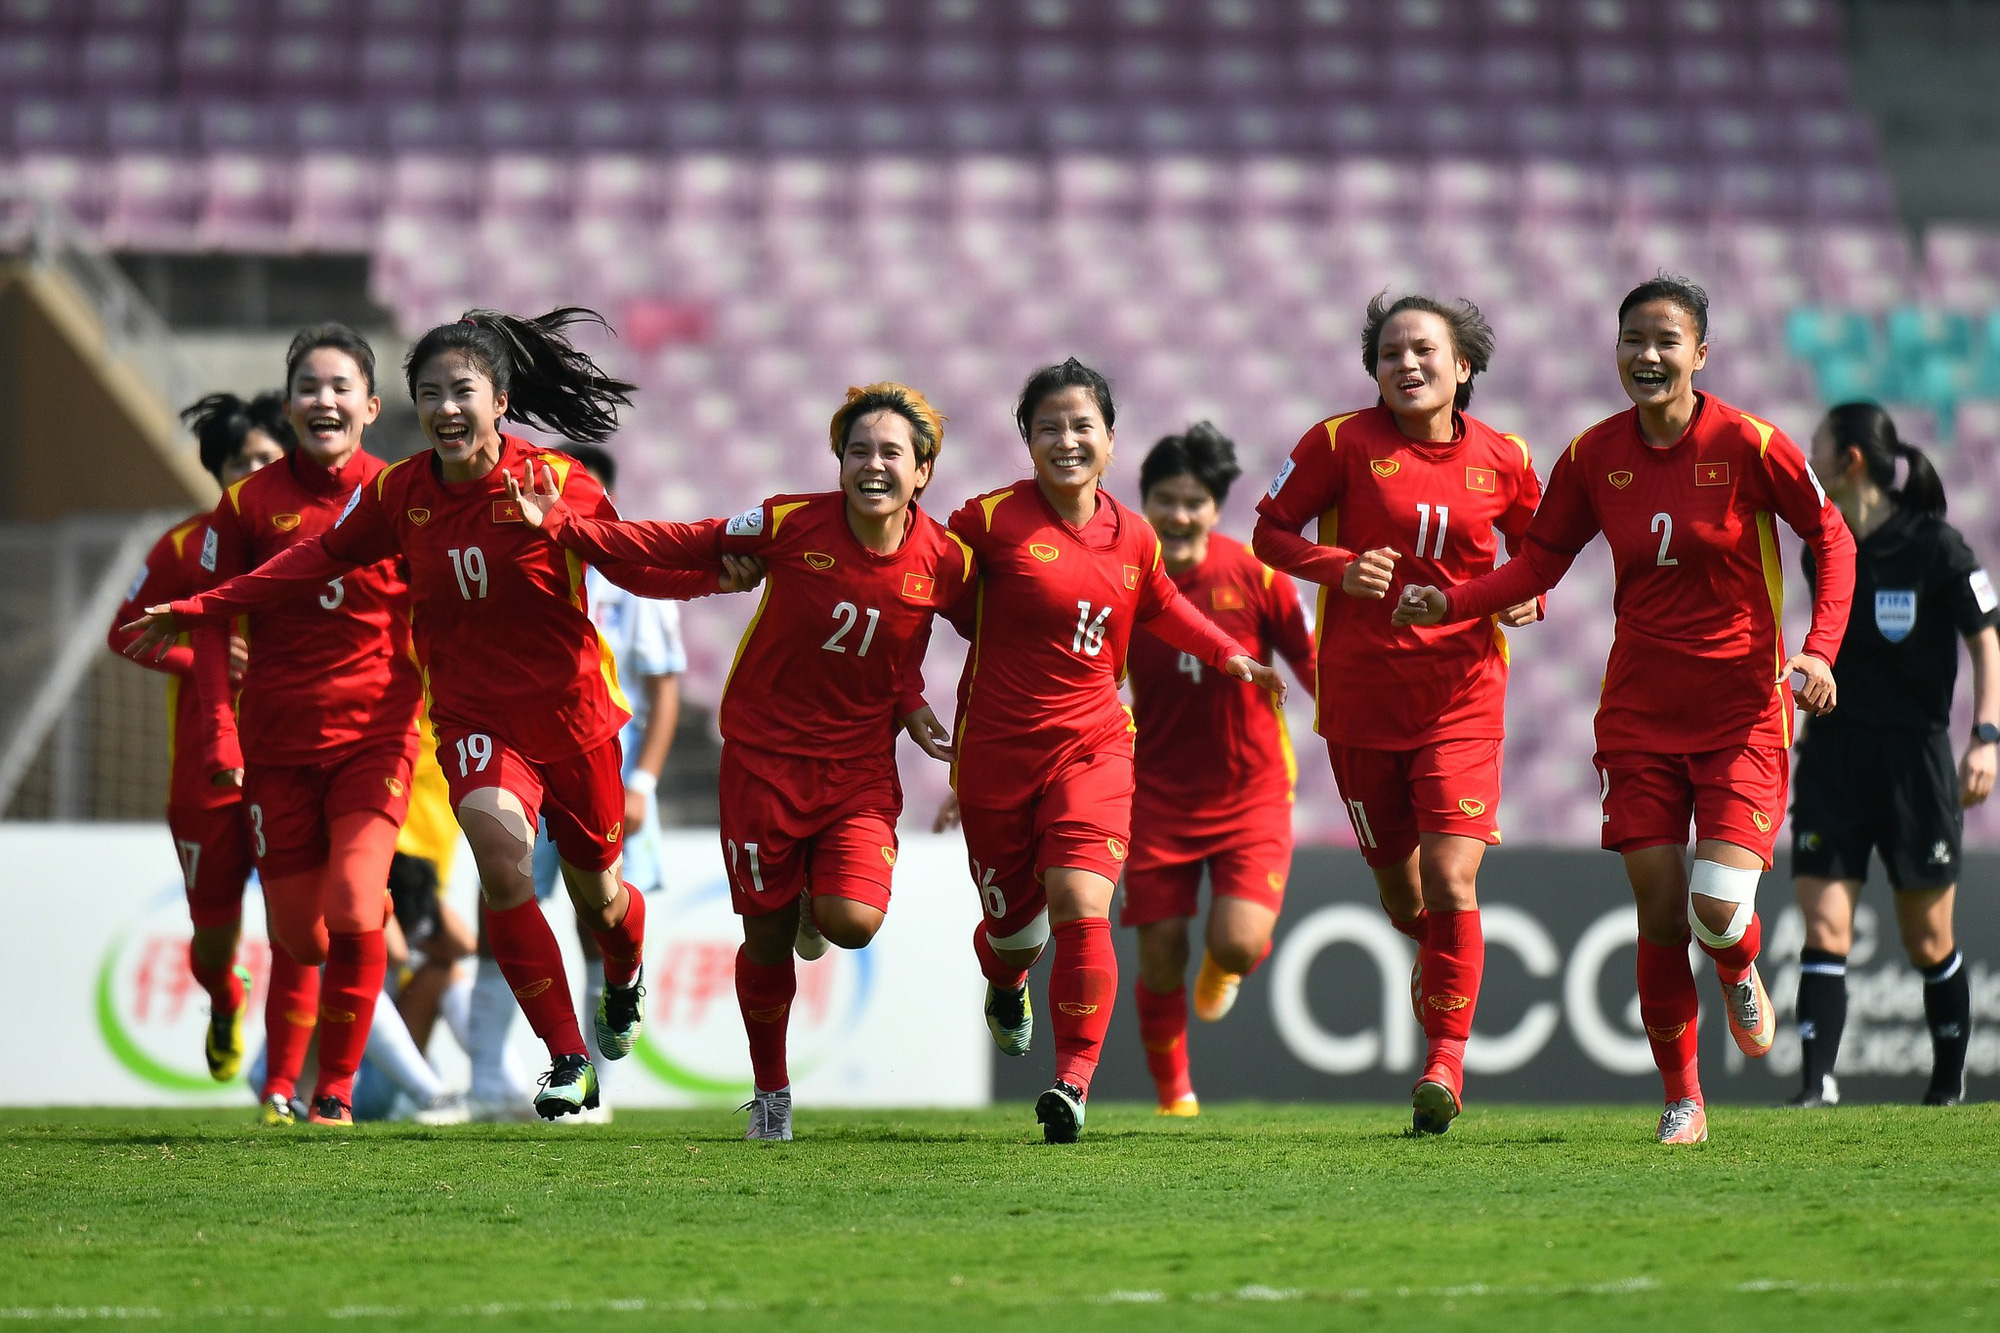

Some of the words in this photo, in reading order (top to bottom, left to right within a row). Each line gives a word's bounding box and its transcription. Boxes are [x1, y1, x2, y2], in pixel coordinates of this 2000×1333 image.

[1416, 502, 1448, 560] 11
[1651, 512, 1678, 566] 2
[320, 576, 345, 610] 3
[448, 546, 488, 600] 19
[821, 601, 880, 657] 21
[1073, 601, 1112, 656] 16
[1178, 650, 1202, 684] 4
[456, 734, 493, 778] 19
[250, 803, 266, 858] 3
[1348, 797, 1377, 848] 11
[973, 858, 1007, 918] 16
